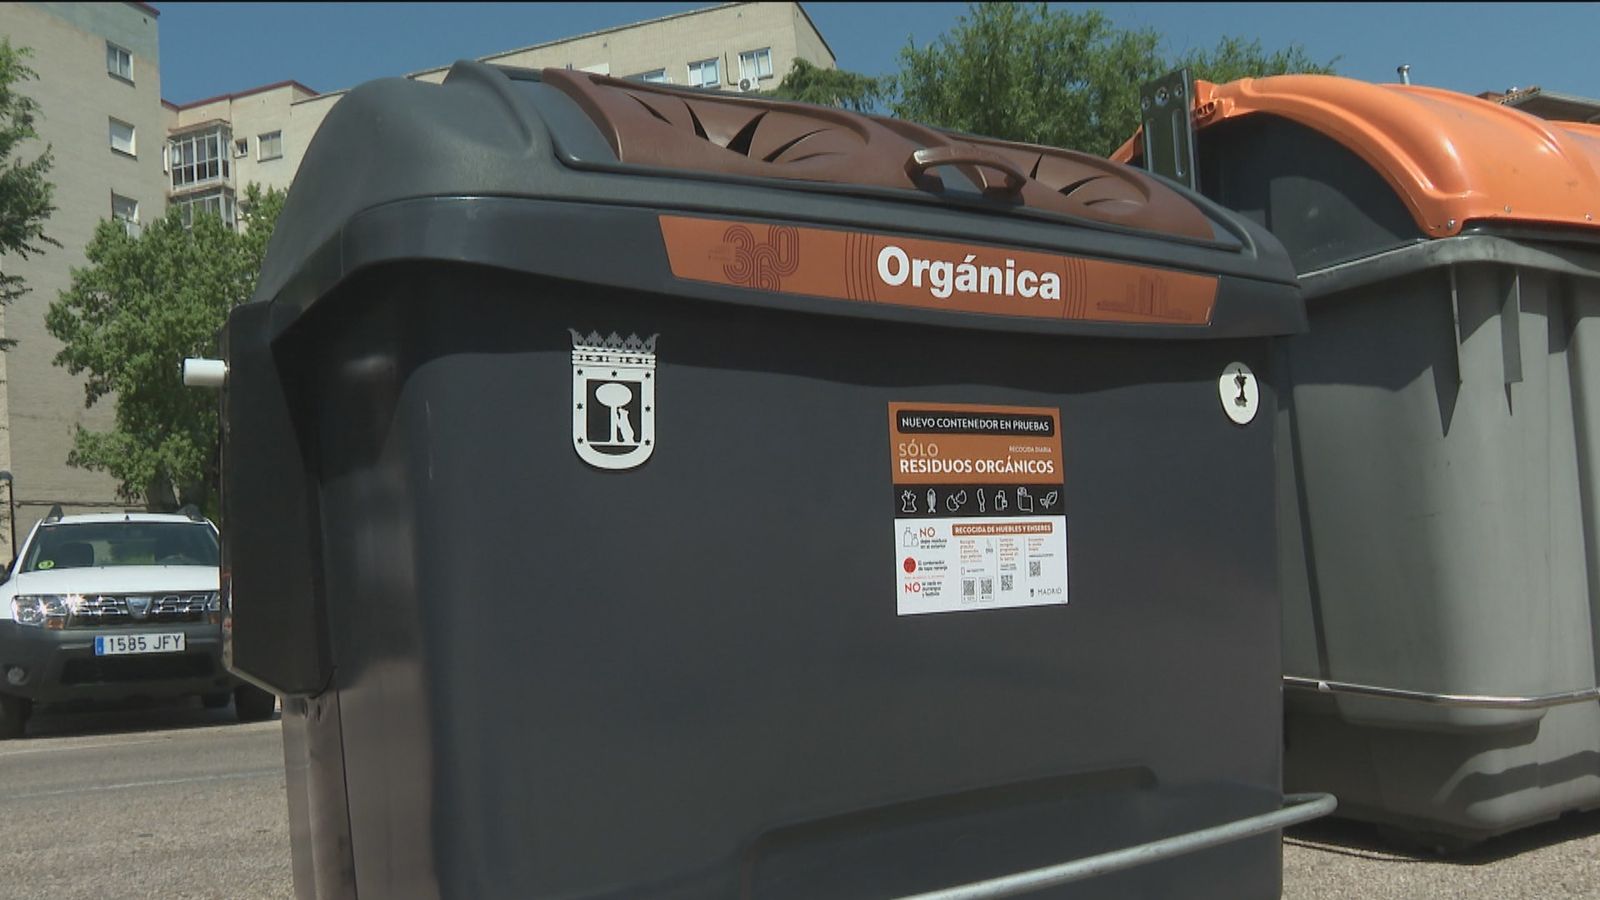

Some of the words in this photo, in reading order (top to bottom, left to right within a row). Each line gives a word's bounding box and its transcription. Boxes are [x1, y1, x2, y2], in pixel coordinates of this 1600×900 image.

[877, 245, 1061, 300] Orgánica
[902, 417, 935, 428] NUEVO
[936, 418, 999, 430] CONTENEDOR
[1000, 420, 1012, 430] EN
[1012, 420, 1050, 431] PRUEBAS
[899, 439, 939, 457] SÓLO
[1009, 445, 1034, 453] RECOGIDA
[900, 459, 972, 473] RESIDUOS
[975, 455, 1054, 474] ORGÁNICOS
[919, 526, 936, 538] NO
[955, 526, 987, 534] RECOGIDA
[987, 526, 995, 534] DE
[995, 525, 1021, 533] MUEBLES
[1021, 525, 1026, 533] Y
[1026, 524, 1051, 532] ENSERES
[904, 581, 921, 593] NO
[1037, 586, 1062, 596] MADRID
[109, 637, 147, 652] 1585
[153, 634, 181, 650] JFY
